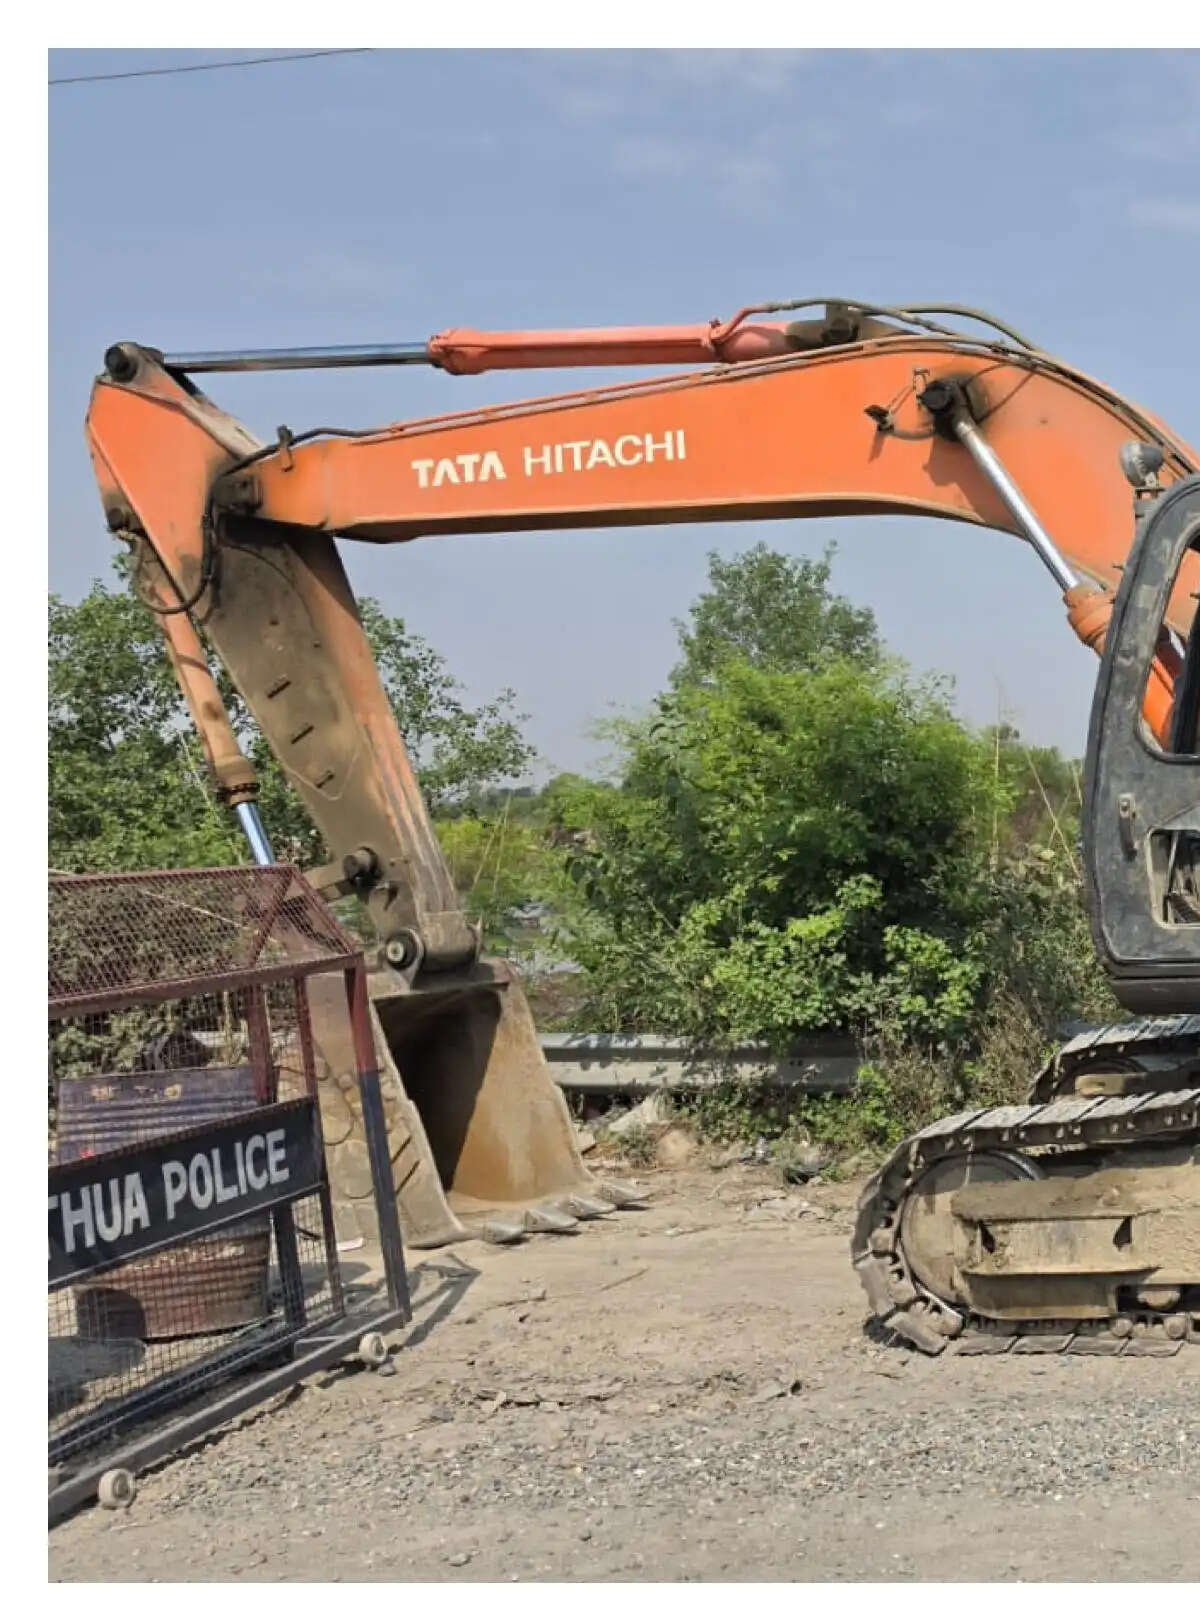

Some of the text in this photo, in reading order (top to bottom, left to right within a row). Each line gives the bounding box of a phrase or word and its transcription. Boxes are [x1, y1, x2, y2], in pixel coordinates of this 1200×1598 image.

[411, 429, 687, 488] TATA HITACHI
[161, 1128, 290, 1221] POLICE
